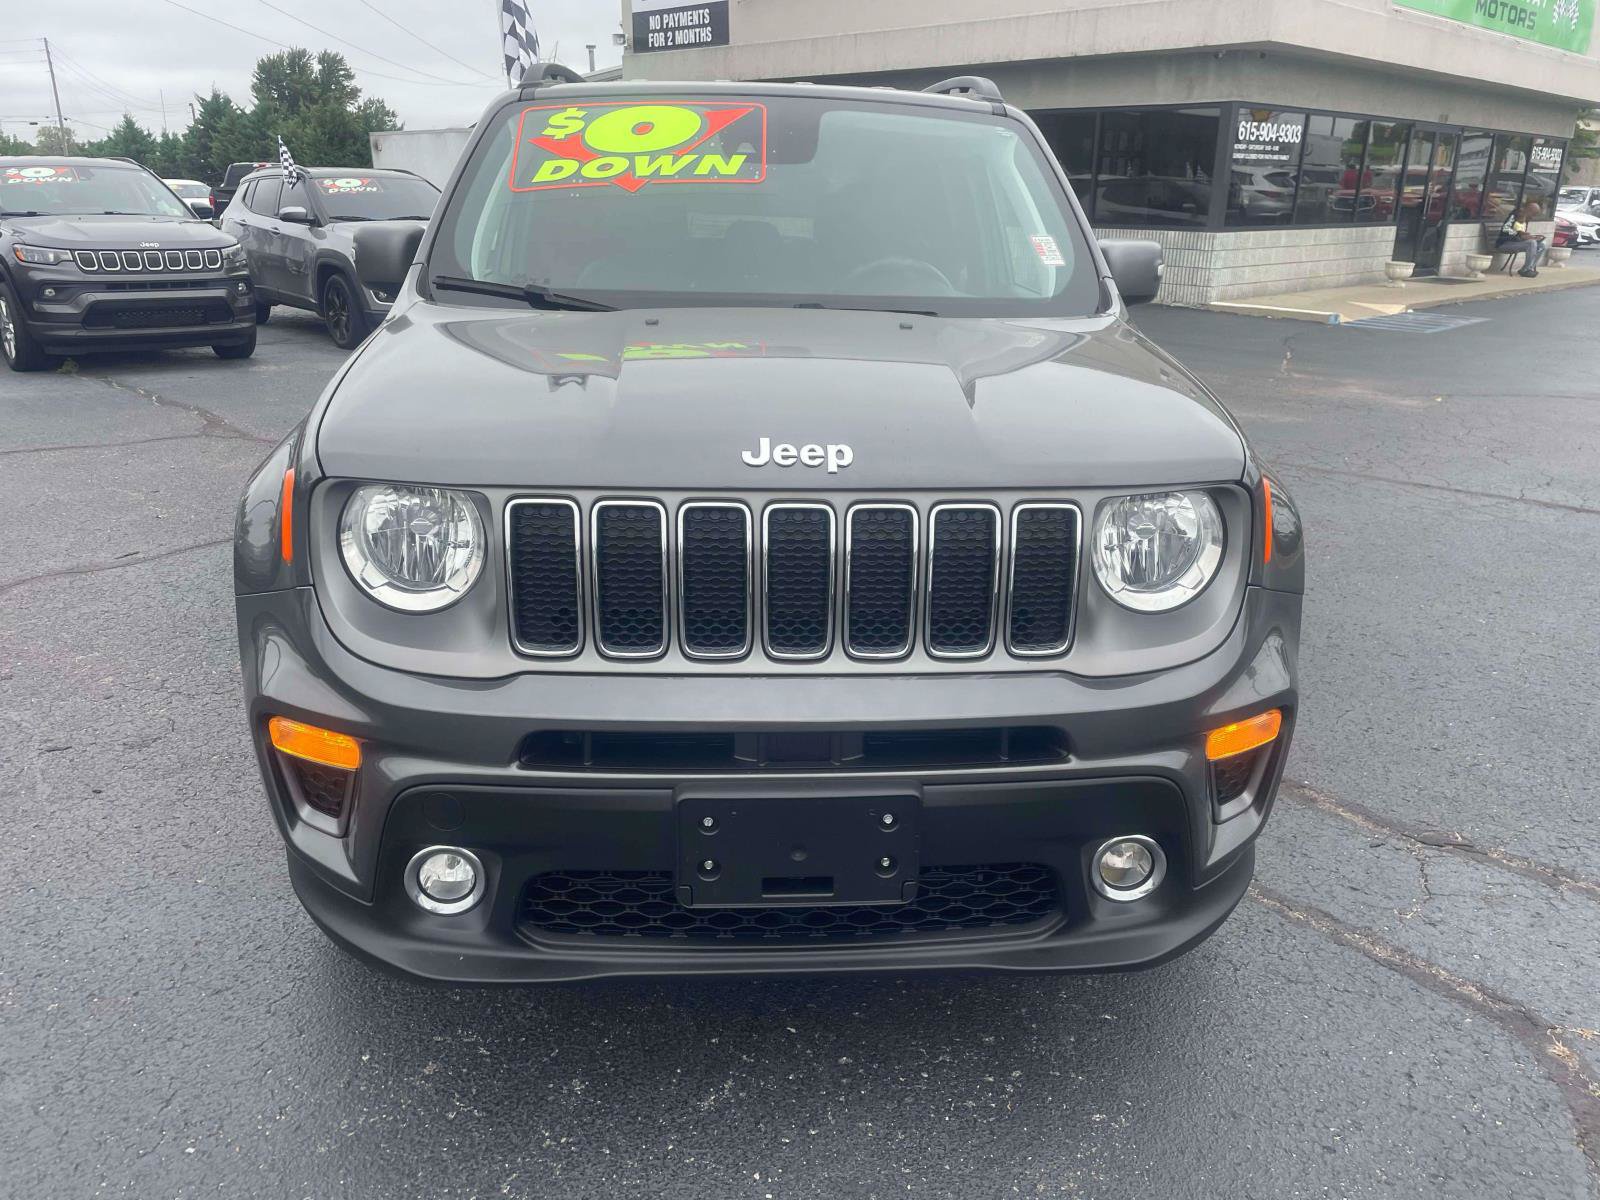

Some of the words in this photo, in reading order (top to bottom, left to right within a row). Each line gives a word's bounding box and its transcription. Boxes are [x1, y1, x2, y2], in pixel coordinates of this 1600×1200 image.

[649, 15, 661, 30] NO
[663, 8, 710, 29] PAYMENTS
[1475, 0, 1538, 30] MOTORS
[648, 33, 665, 48] FOR
[667, 33, 674, 46] 2
[675, 27, 712, 45] MONTHS
[1238, 120, 1302, 143] 615-904-9303
[531, 154, 748, 183] DOWN
[741, 437, 854, 474] Jeep
